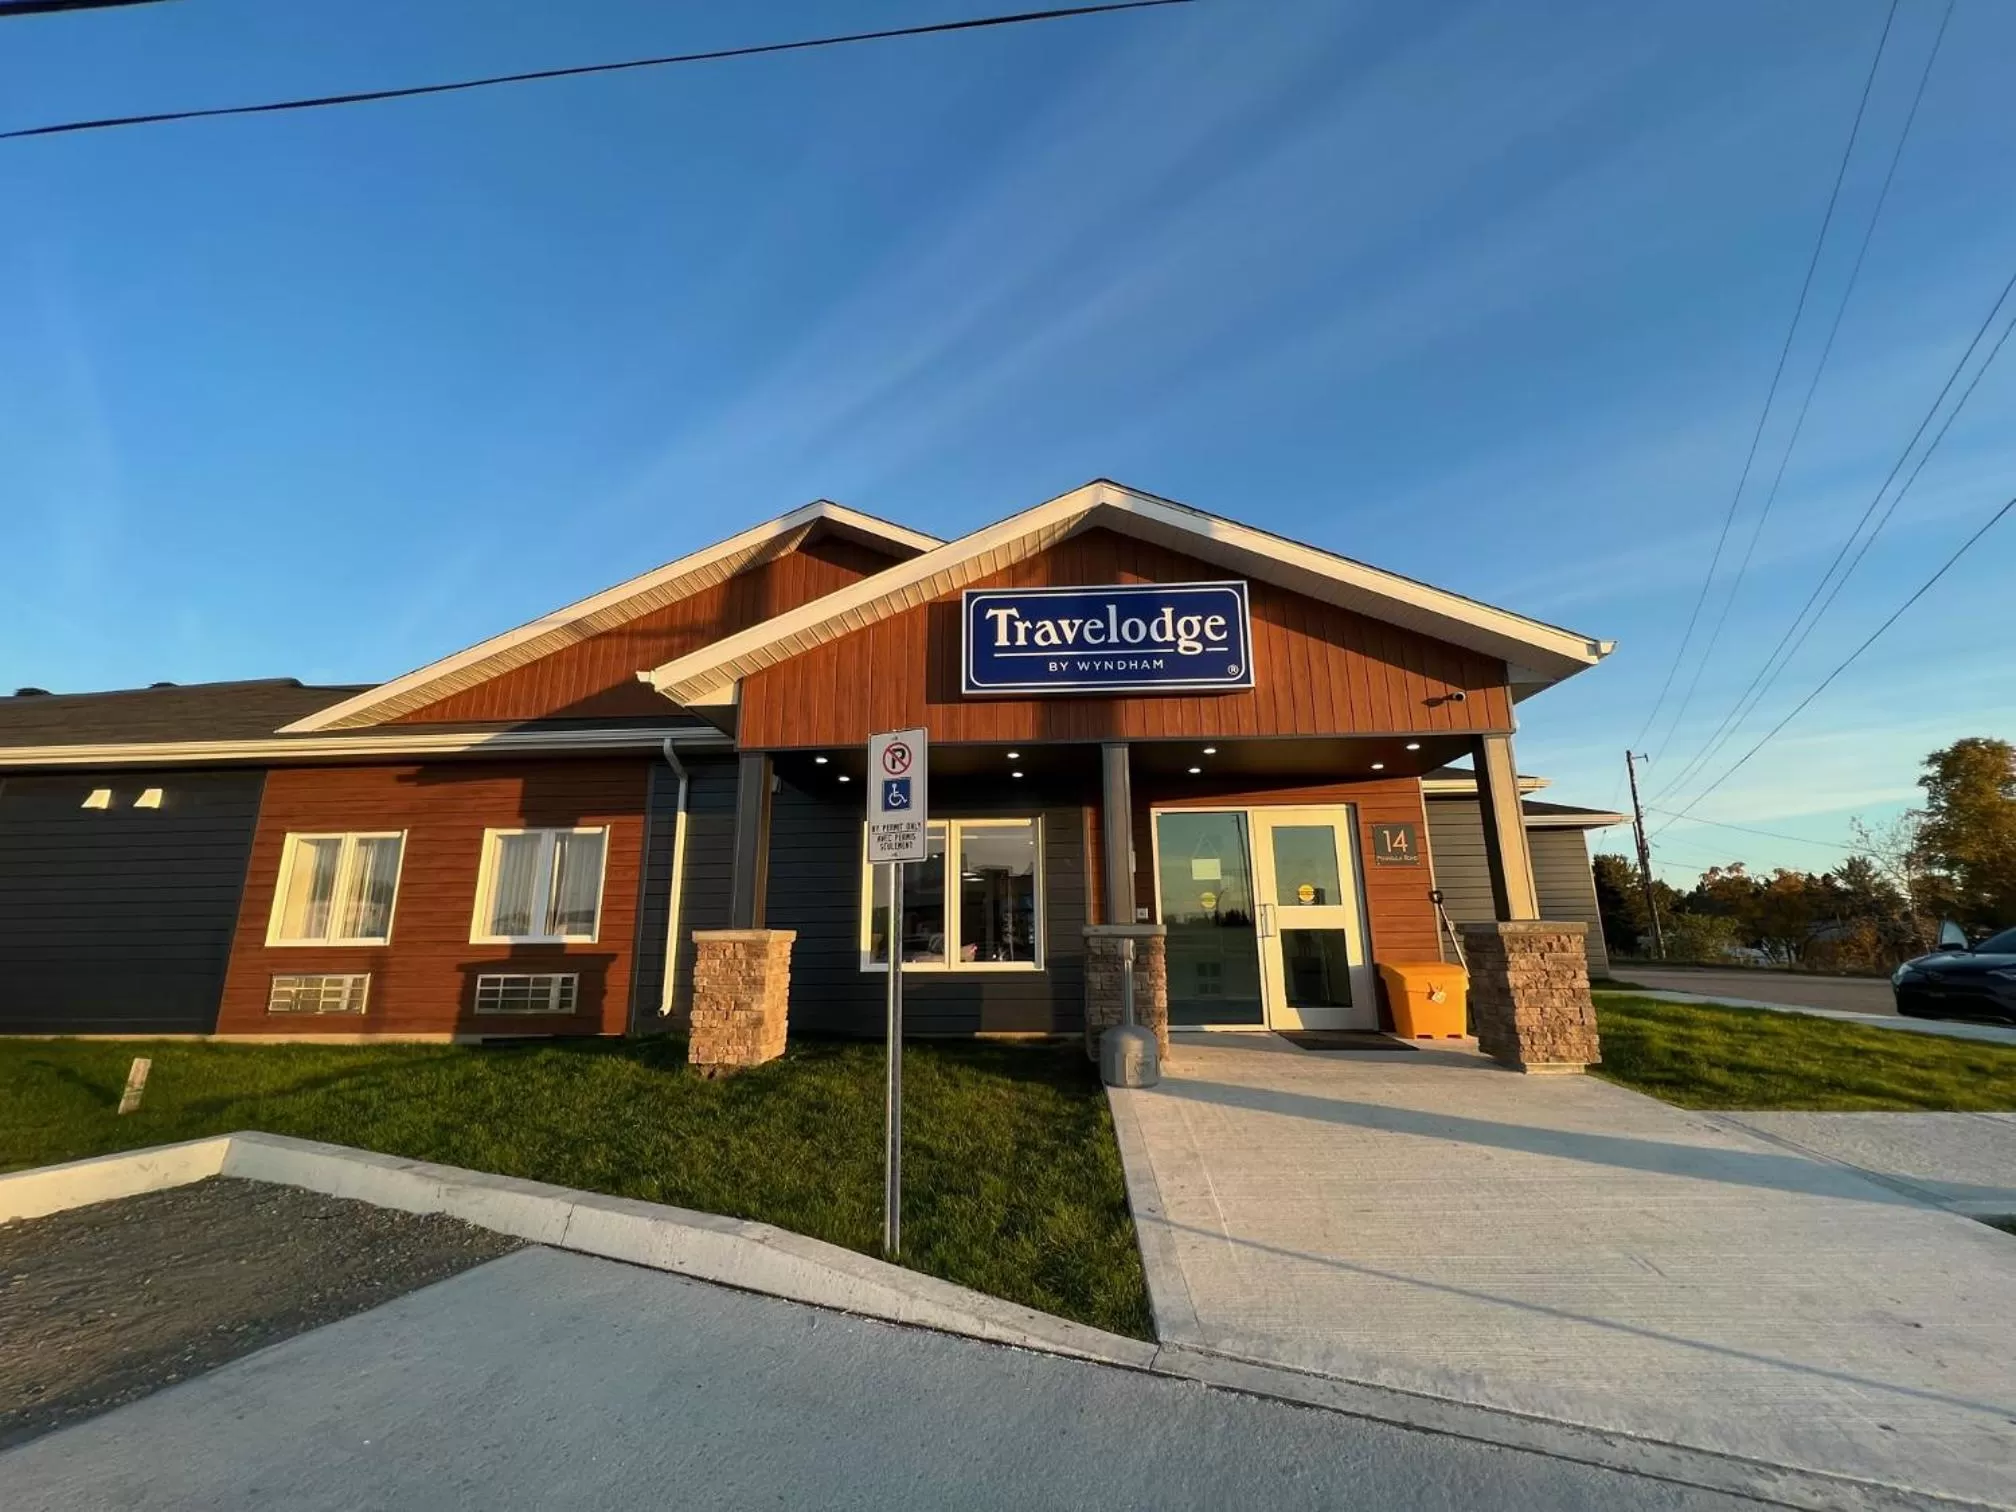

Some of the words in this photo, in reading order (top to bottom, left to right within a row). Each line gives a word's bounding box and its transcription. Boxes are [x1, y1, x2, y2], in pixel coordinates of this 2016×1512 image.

[985, 604, 1228, 655] Travelodge
[1049, 661, 1069, 673] BY
[1077, 659, 1164, 672] WYNDHAM
[1383, 830, 1408, 852] 14
